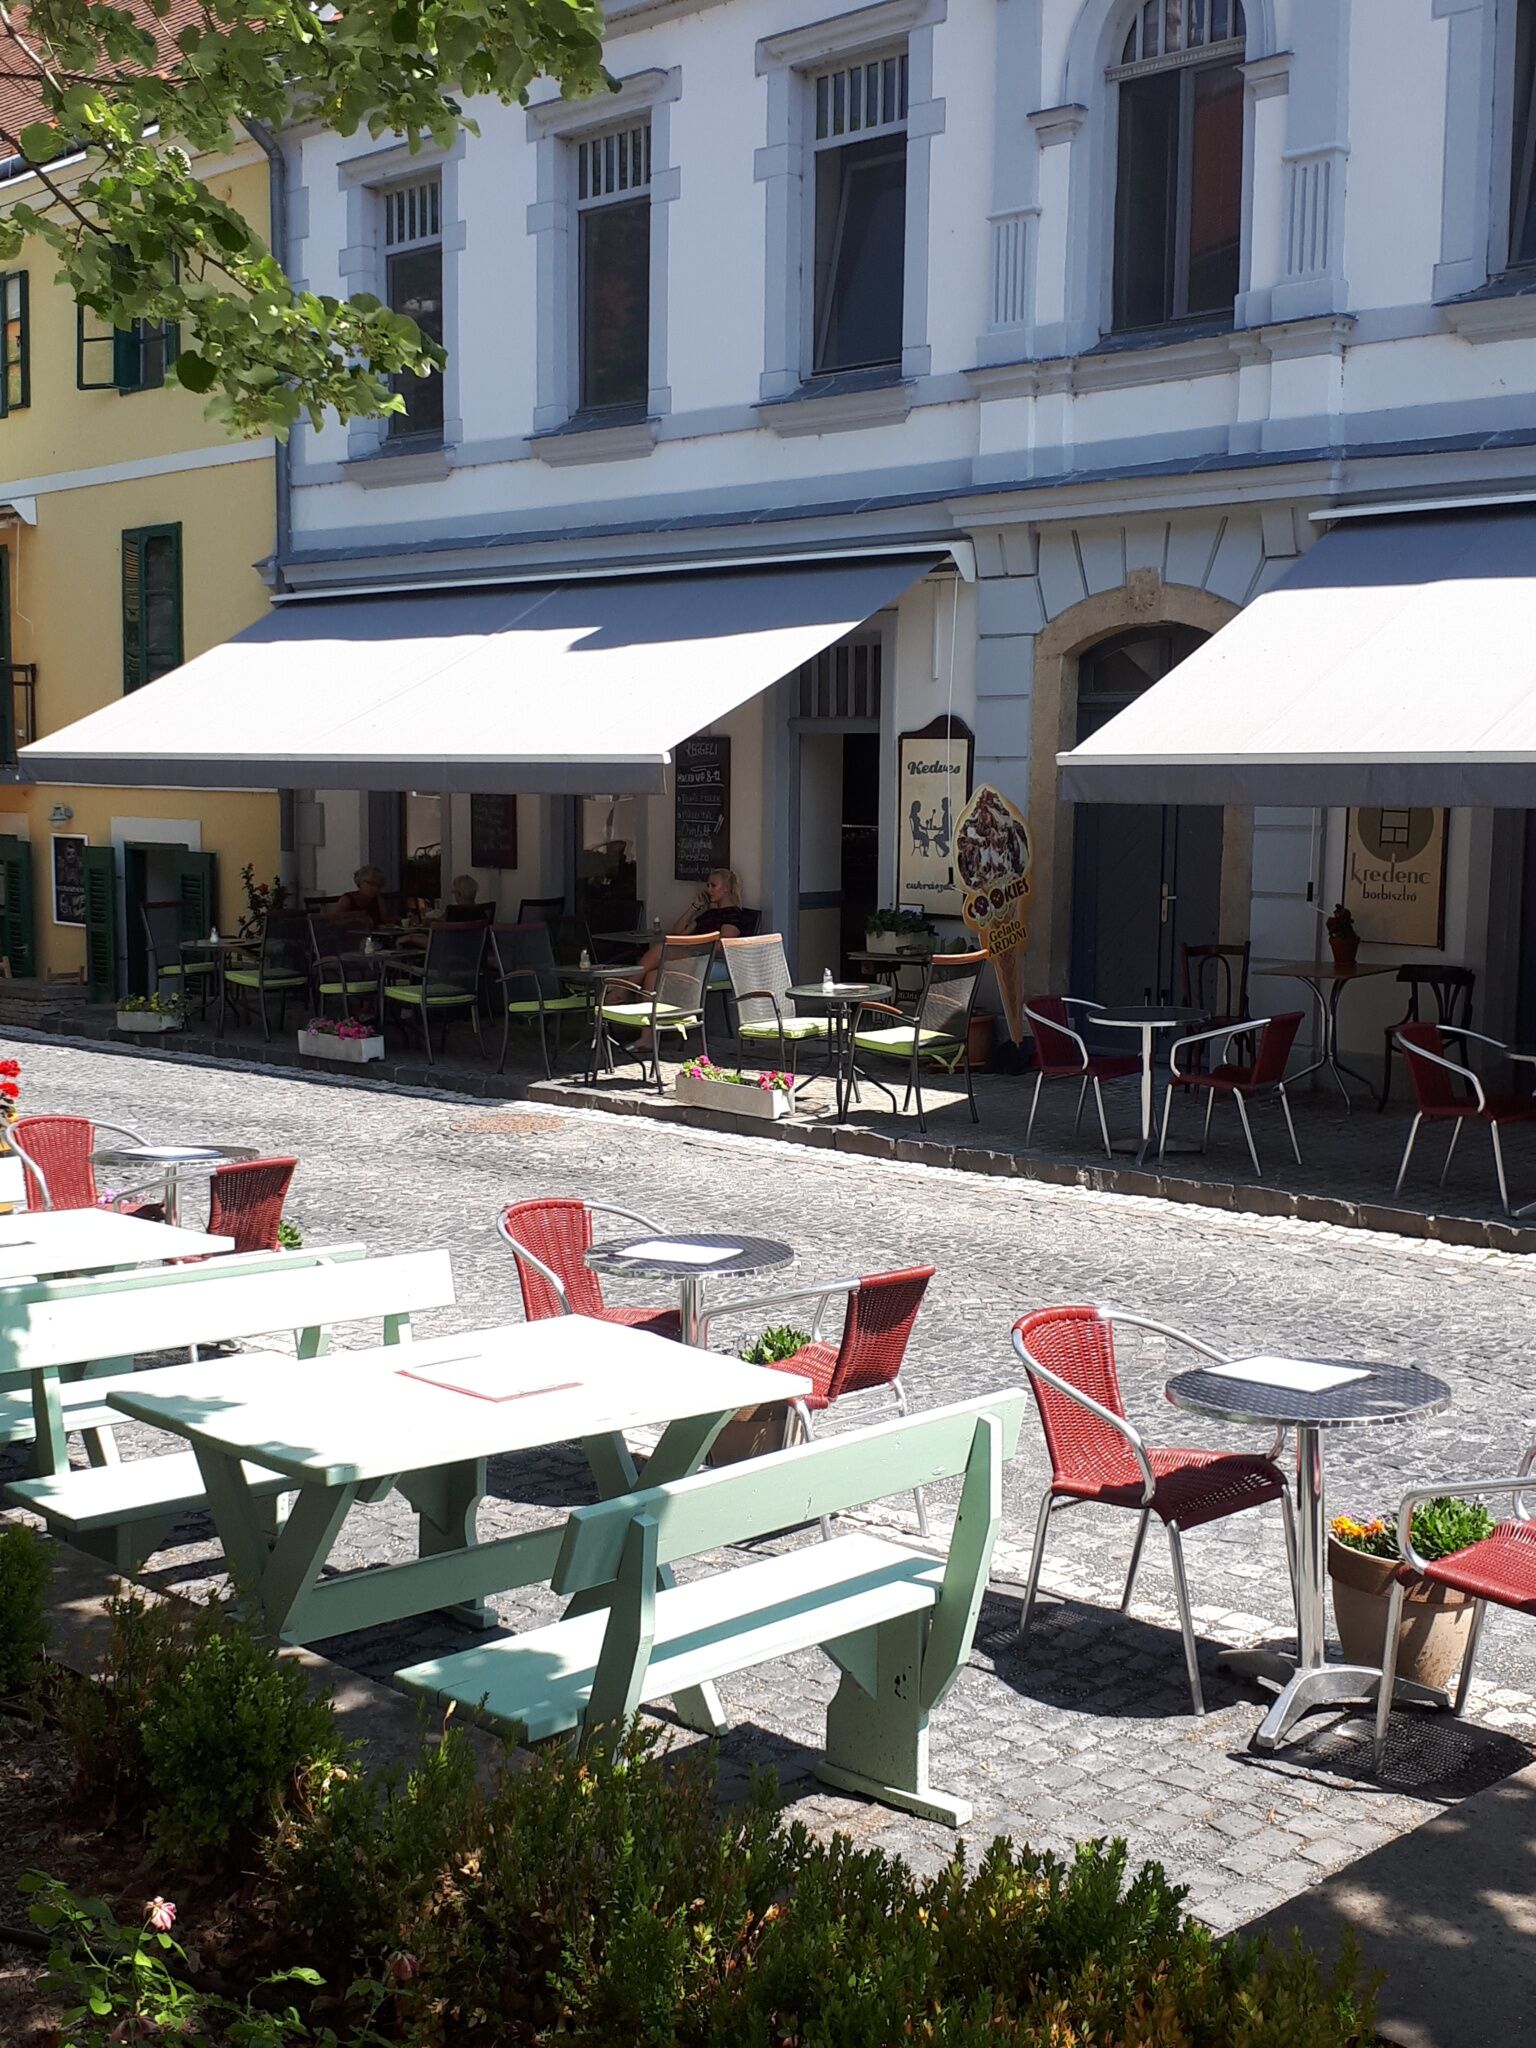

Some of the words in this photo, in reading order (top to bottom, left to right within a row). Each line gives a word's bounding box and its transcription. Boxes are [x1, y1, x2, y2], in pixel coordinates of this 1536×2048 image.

[907, 761, 961, 775] Kedves
[1351, 852, 1432, 885] kredenc
[967, 878, 1030, 918] COOKIES
[1362, 883, 1417, 901] borbisztró
[988, 921, 1021, 942] Gelato
[988, 927, 1027, 957] ARDONI
